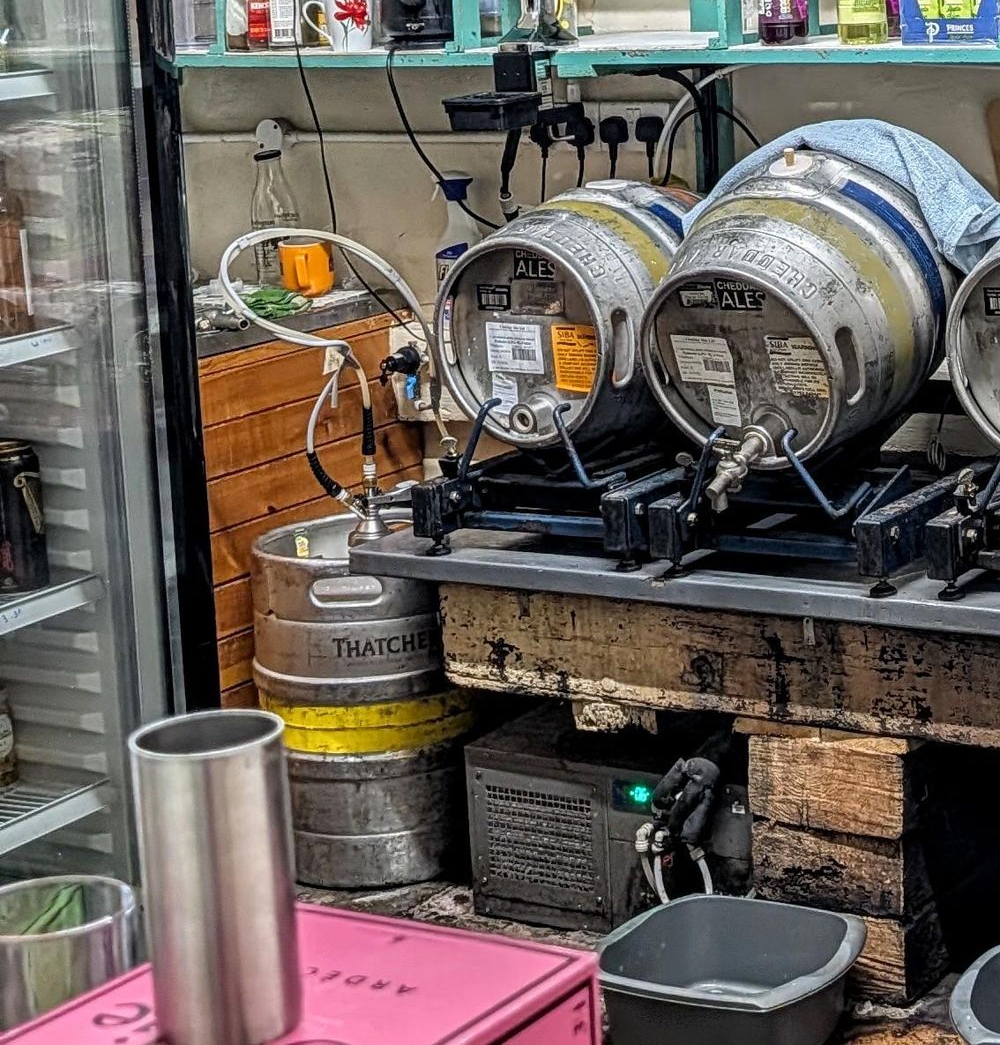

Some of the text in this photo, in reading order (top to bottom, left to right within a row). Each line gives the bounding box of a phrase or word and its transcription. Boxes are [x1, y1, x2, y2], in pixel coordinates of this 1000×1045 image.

[516, 260, 555, 278] ALES
[721, 291, 765, 309] ALES
[557, 331, 575, 339] SIBA
[769, 340, 789, 349] SIBA
